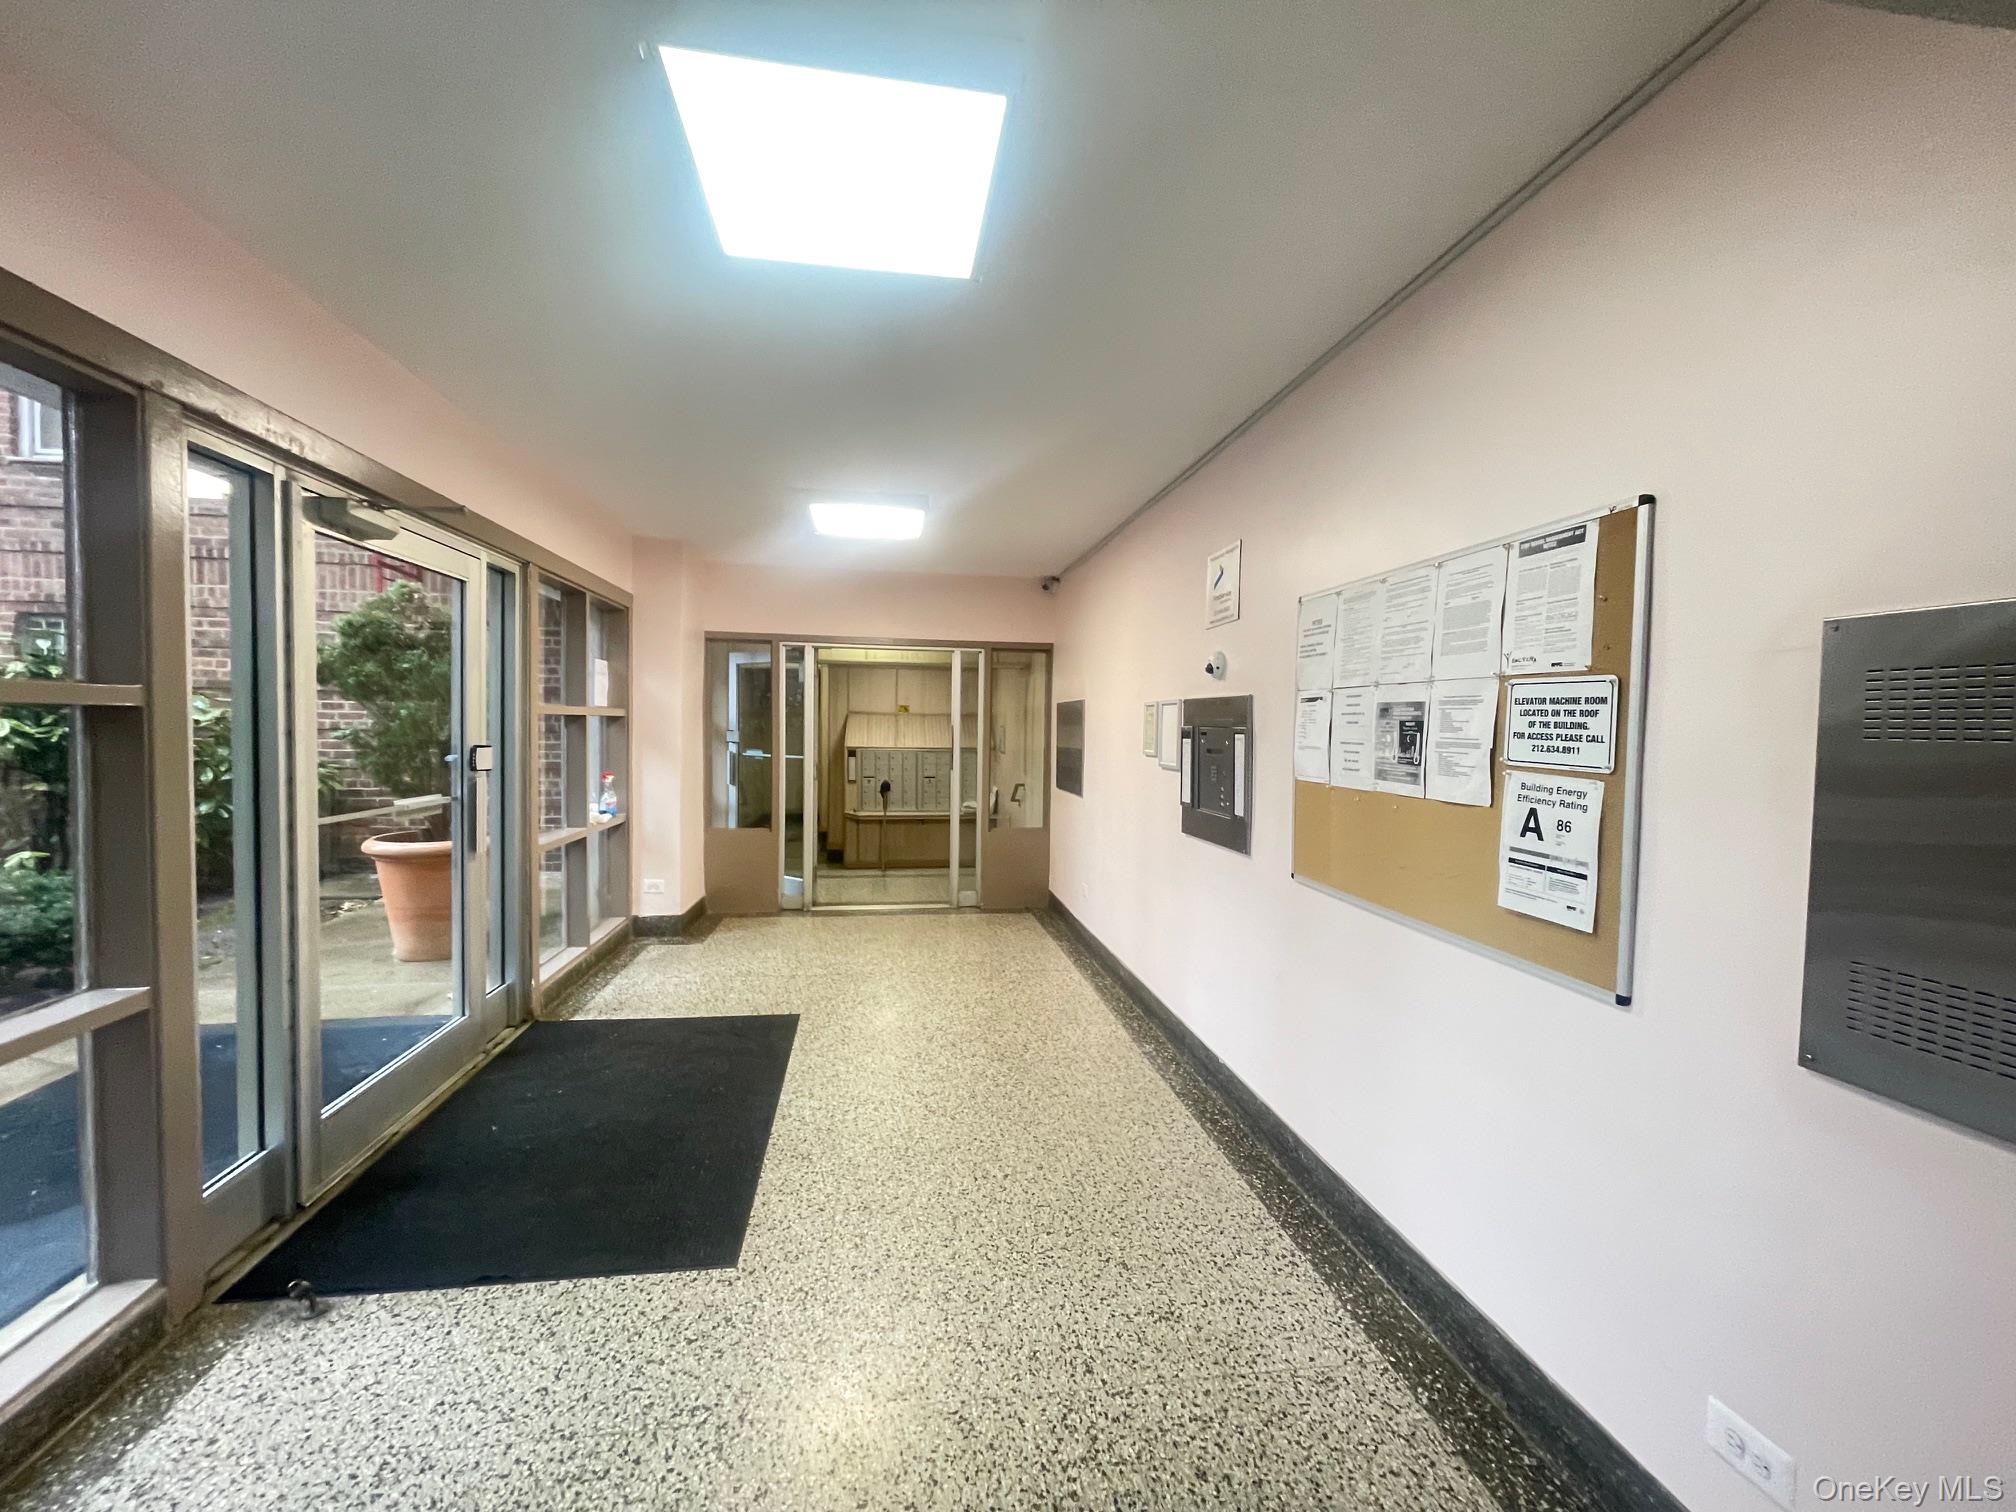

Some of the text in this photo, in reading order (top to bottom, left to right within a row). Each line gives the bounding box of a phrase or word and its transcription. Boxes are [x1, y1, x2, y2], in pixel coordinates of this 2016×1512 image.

[1514, 696, 1608, 705] ELEVATOR MACHINE ROOM
[1519, 709, 1600, 718] LOCATED ON THE ROOF
[1528, 721, 1536, 729] OF
[1539, 721, 1551, 729] THE
[1527, 732, 1554, 741] ACCESS
[1555, 733, 1583, 743] PLEASE
[1585, 735, 1606, 743] CALL
[1520, 782, 1588, 800] Building Energy
[1517, 794, 1588, 813] Efficiency Rating
[1519, 807, 1544, 842] A
[1556, 819, 1572, 833] 86
